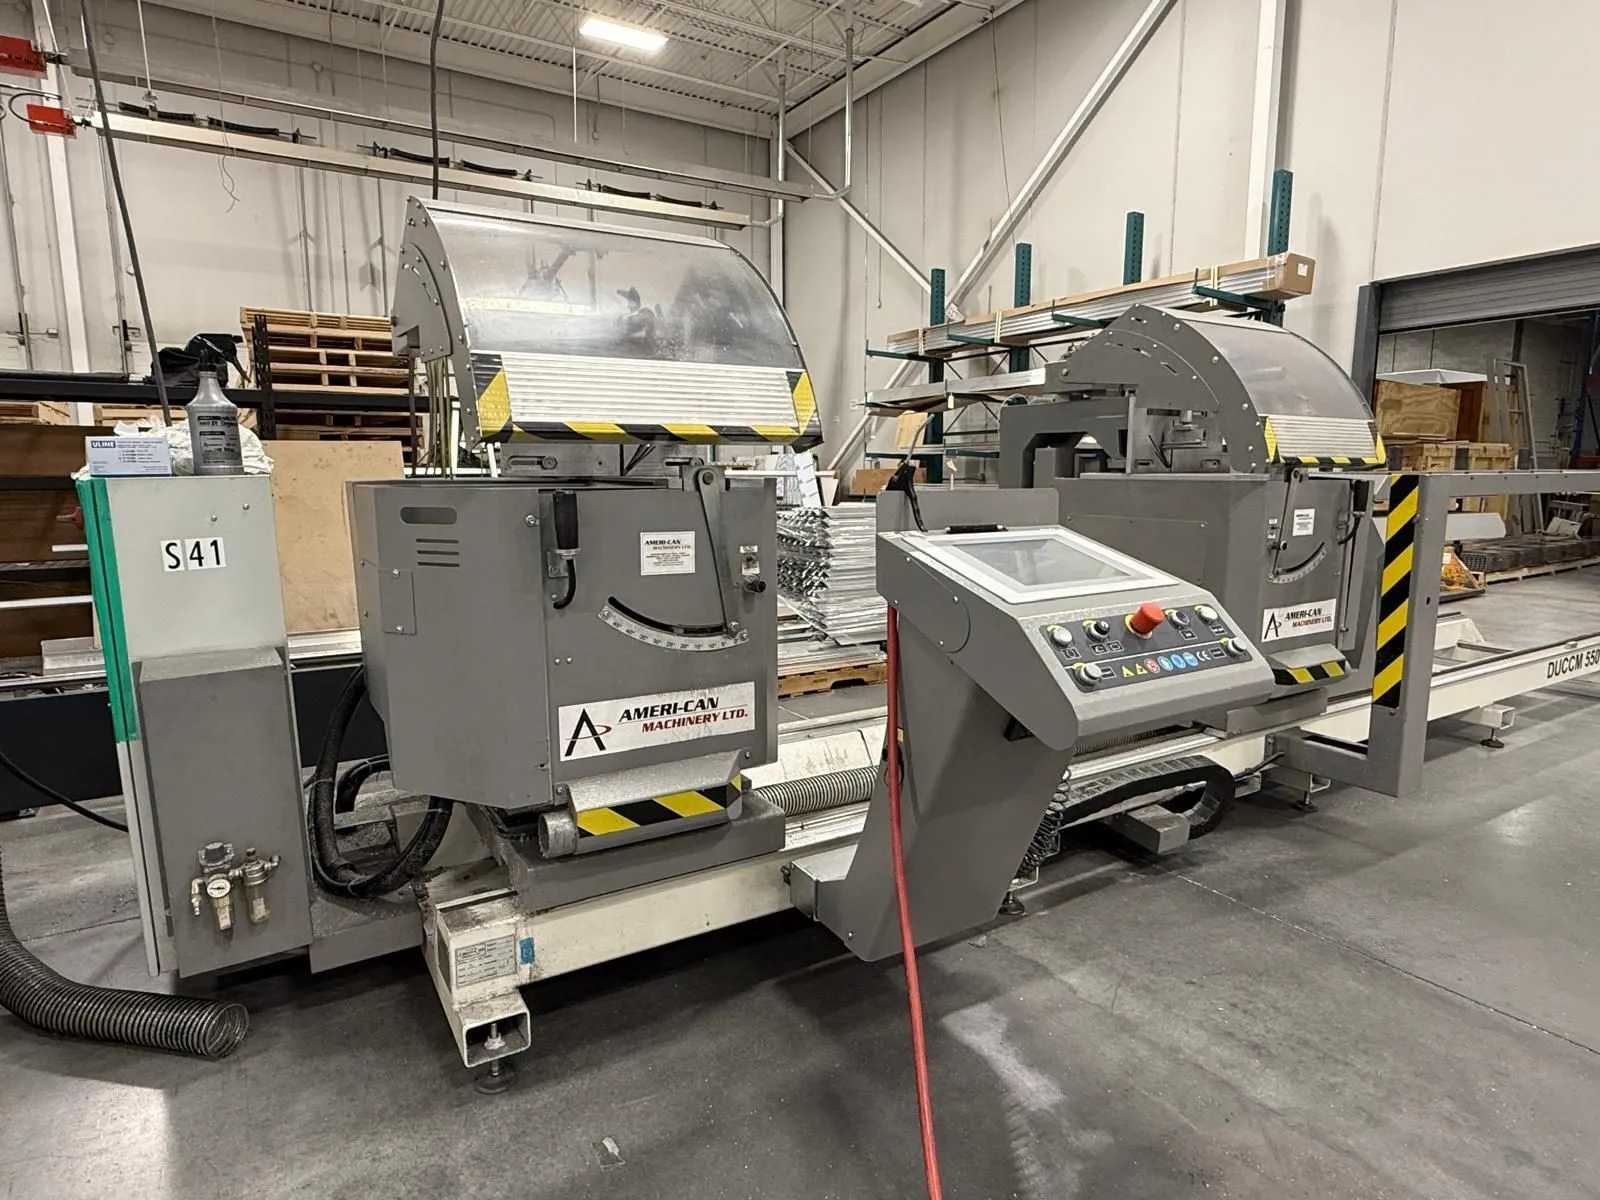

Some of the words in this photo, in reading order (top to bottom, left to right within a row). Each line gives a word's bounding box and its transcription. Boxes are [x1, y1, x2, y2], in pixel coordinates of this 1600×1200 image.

[91, 441, 115, 449] ULINE
[165, 540, 221, 569] S41
[1285, 608, 1323, 620] AMERI-CAN
[619, 697, 719, 723] AMERI-CAN
[642, 711, 720, 733] MACHINERY
[722, 708, 748, 721] LTD.
